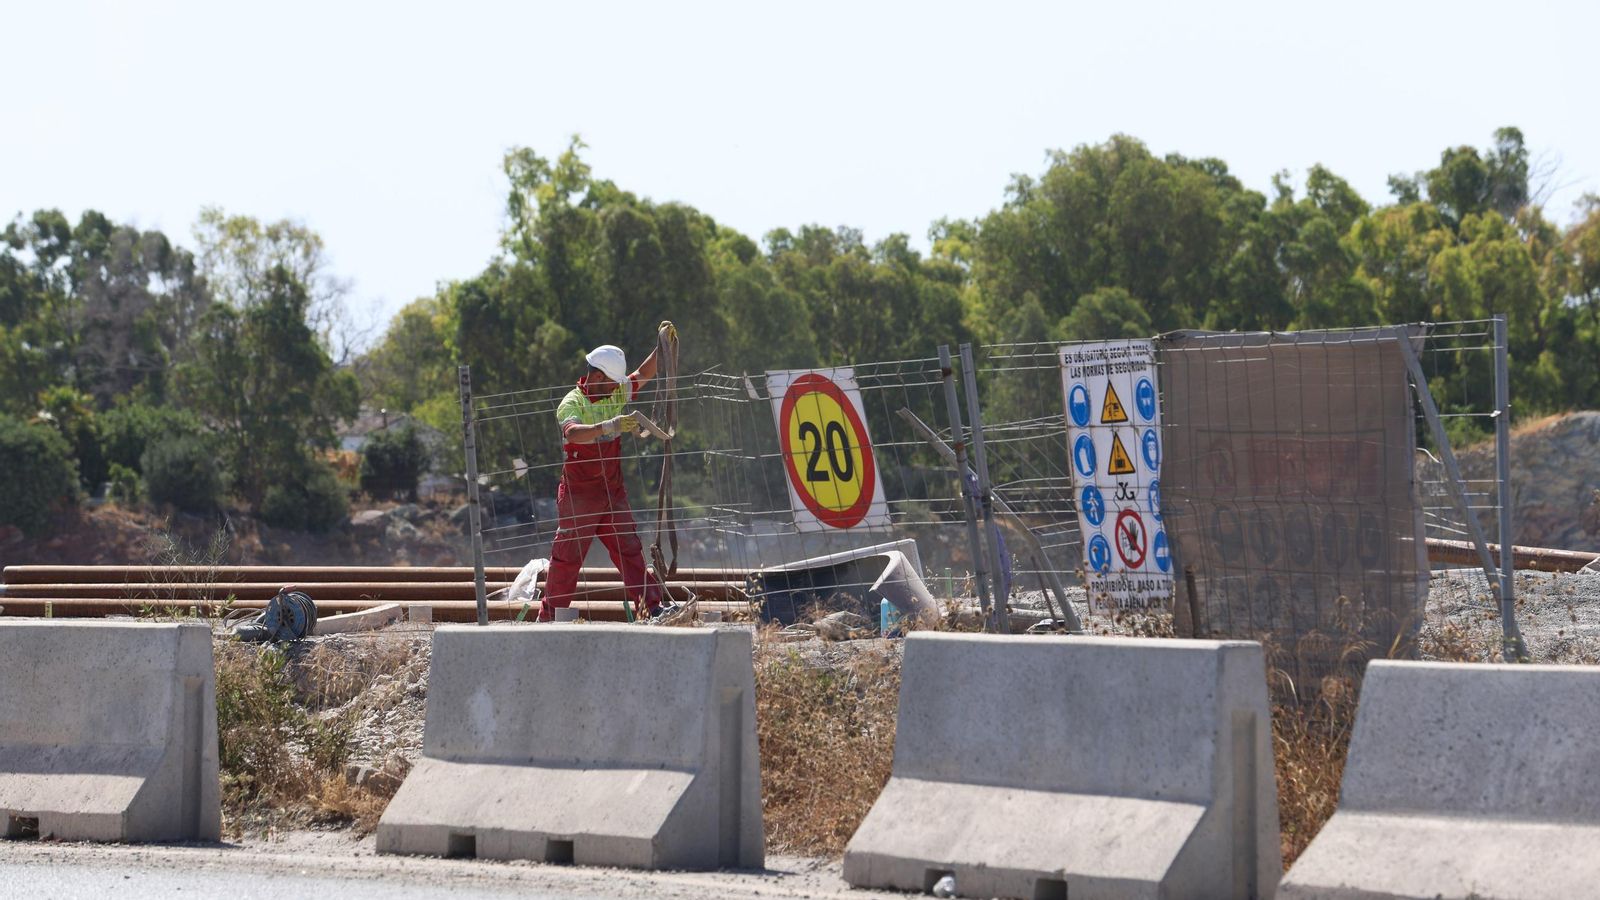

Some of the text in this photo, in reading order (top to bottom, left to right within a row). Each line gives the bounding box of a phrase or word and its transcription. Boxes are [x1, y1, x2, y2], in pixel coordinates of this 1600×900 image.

[1064, 354, 1072, 364] ES
[1070, 367, 1081, 379] LAS
[1083, 364, 1104, 377] NORMAS
[1115, 361, 1147, 374] SEGURIDAD
[798, 421, 853, 482] 20
[1091, 580, 1127, 593] PROHIBIDO
[1128, 580, 1136, 592] EL
[1157, 580, 1161, 591] A
